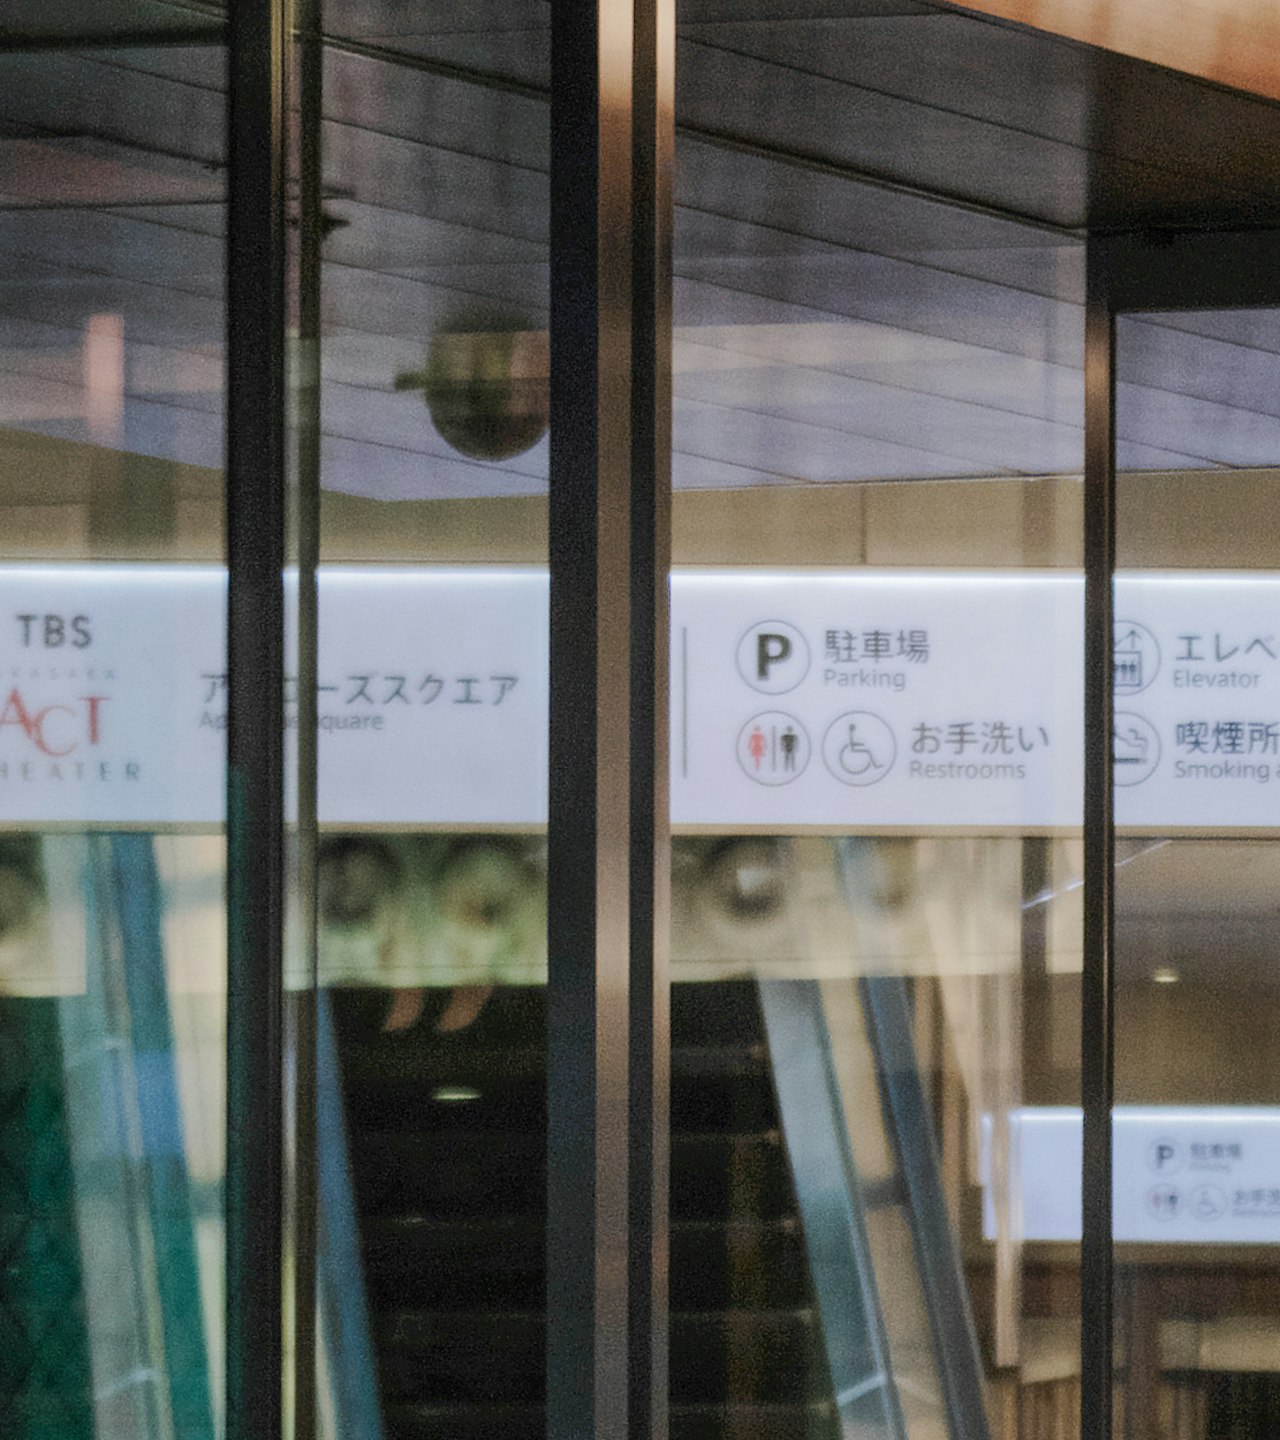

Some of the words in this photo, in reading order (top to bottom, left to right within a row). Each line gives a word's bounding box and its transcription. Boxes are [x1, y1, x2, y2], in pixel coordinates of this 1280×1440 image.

[17, 615, 92, 648] TBS
[823, 629, 930, 664] 駐車場
[757, 634, 792, 681] P
[823, 669, 906, 692] Parking
[1173, 669, 1260, 688] Elevator
[911, 721, 1049, 755] お手洗い
[1174, 721, 1280, 755] 喫煙所
[909, 761, 1026, 779] Restrooms
[1174, 761, 1270, 782] Smoking
